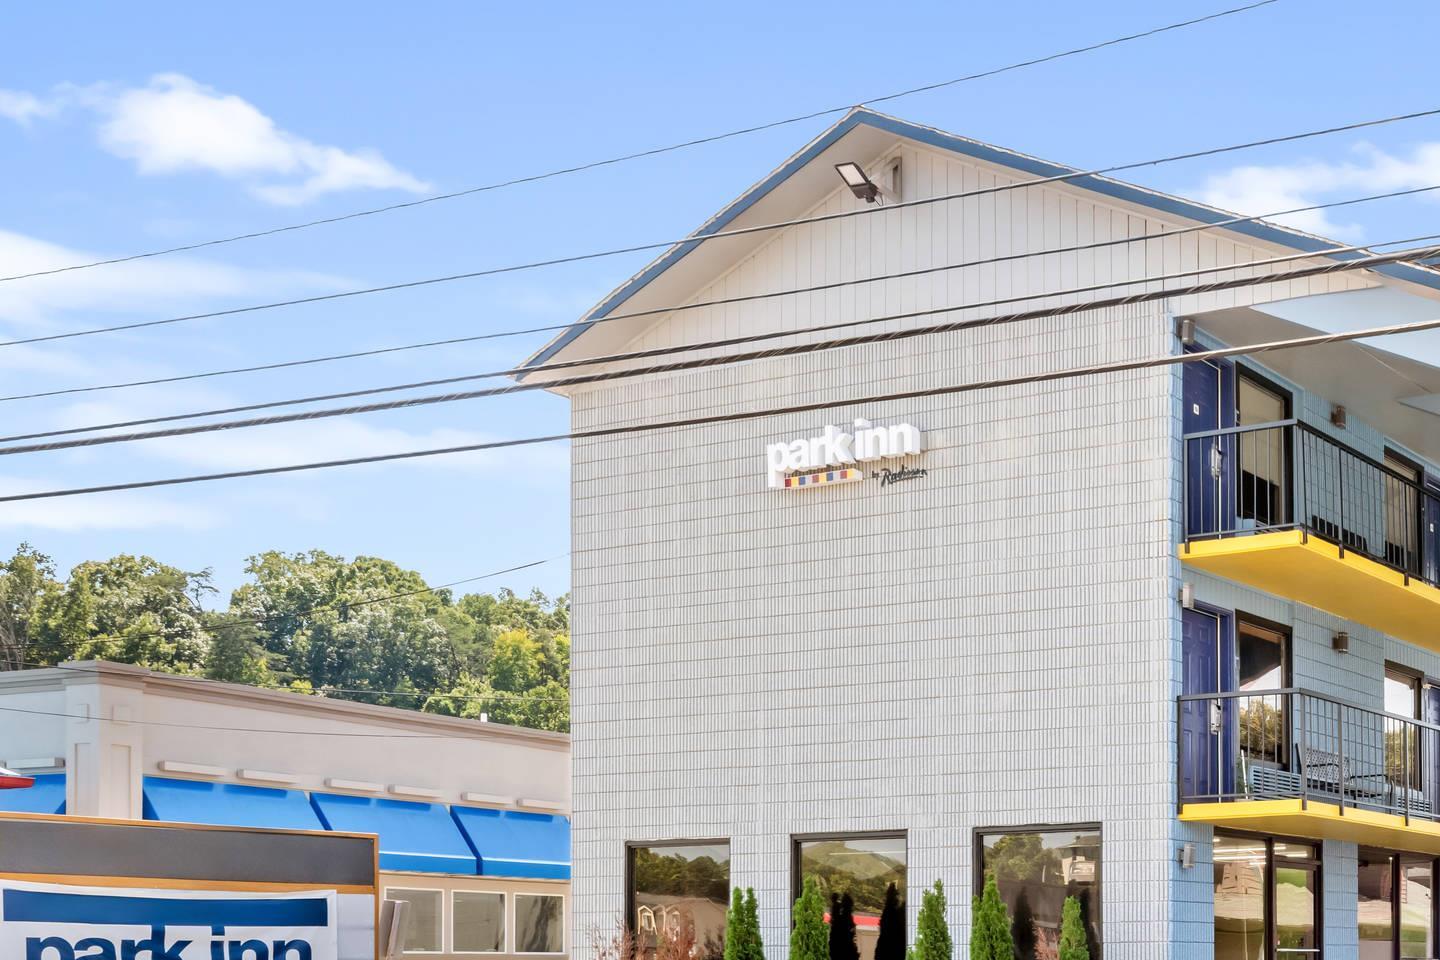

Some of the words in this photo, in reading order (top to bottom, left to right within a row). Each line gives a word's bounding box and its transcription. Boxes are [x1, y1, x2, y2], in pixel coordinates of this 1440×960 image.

[767, 424, 857, 488] park
[854, 417, 921, 462] inn
[871, 470, 880, 481] by
